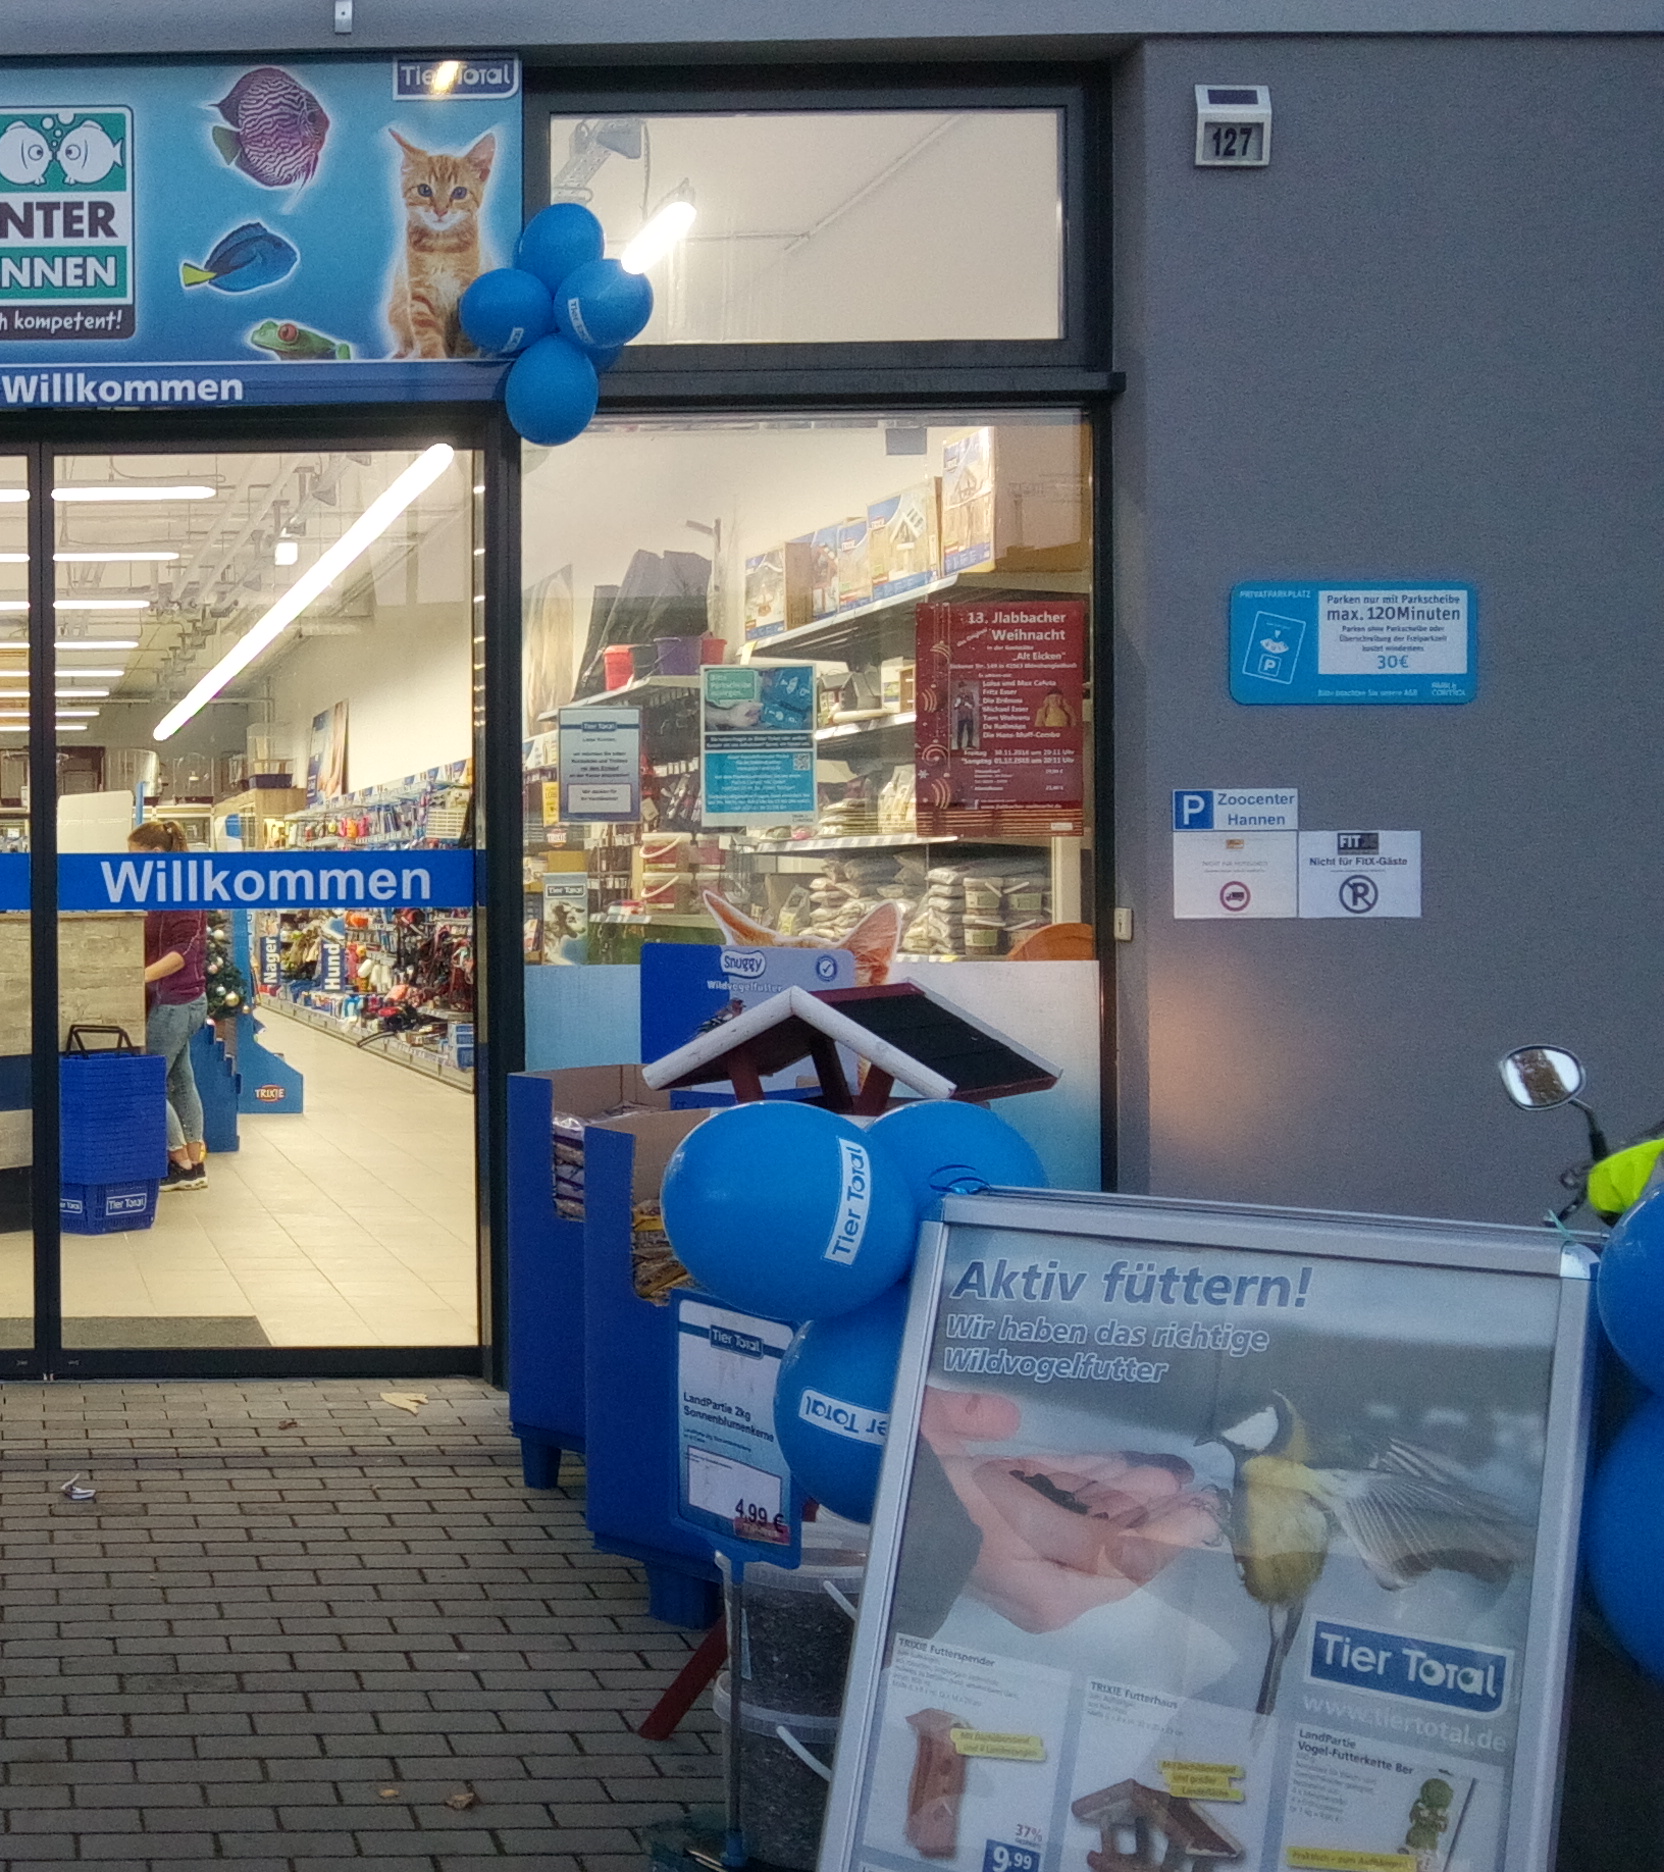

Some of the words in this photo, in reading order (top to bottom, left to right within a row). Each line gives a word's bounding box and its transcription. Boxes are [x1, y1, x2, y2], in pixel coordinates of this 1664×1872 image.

[1212, 127, 1253, 156] 127
[14, 309, 123, 333] kompetent!
[1, 373, 243, 403] Willkommen
[1327, 595, 1360, 604] Parken
[1382, 595, 1398, 604] mit
[1401, 595, 1460, 604] Parkscheibe
[967, 612, 988, 624] 13.
[992, 611, 1066, 624] Jlabbacher
[1327, 608, 1364, 621] max.
[991, 629, 1065, 641] Weihnacht
[1217, 793, 1295, 806] Zoocenter
[1227, 814, 1285, 825] Hannen
[1309, 857, 1335, 866] Nicht
[1338, 857, 1355, 866] für
[100, 859, 430, 903] Willkommen
[264, 937, 280, 983] Nager
[324, 943, 341, 990] Hund
[724, 955, 762, 973] Snuggy
[707, 980, 783, 992] Wildvogelfutter
[255, 1088, 284, 1098] TRIXIE
[108, 1200, 124, 1210] Tier
[832, 1209, 861, 1256] Tier
[847, 1146, 863, 1201] Total
[949, 1259, 1087, 1301] Aktiv
[1102, 1260, 1313, 1308] füttern!
[711, 1328, 733, 1344] Tier
[735, 1334, 761, 1352] Total
[946, 1314, 994, 1339] Wir
[998, 1316, 1086, 1344] haben
[1094, 1320, 1145, 1346] das
[1152, 1322, 1270, 1357] richtige
[944, 1347, 1169, 1383] Wildvogelfutter
[683, 1391, 733, 1415] LandPartie
[735, 1405, 751, 1423] 2kg
[805, 1396, 859, 1433] Total
[683, 1405, 774, 1443] Sonnenblumenkerne
[930, 1645, 995, 1667] Futterspender
[1320, 1631, 1394, 1676] Tier
[1402, 1648, 1497, 1698] Total
[1091, 1681, 1122, 1696] TRIXIE
[1125, 1689, 1178, 1709] Futterhaus
[1303, 1695, 1507, 1752] www.tiertotal.de
[1299, 1729, 1356, 1749] LandPartie
[1298, 1740, 1393, 1771] Vogel-Futterkette
[1015, 1823, 1043, 1842] 37%
